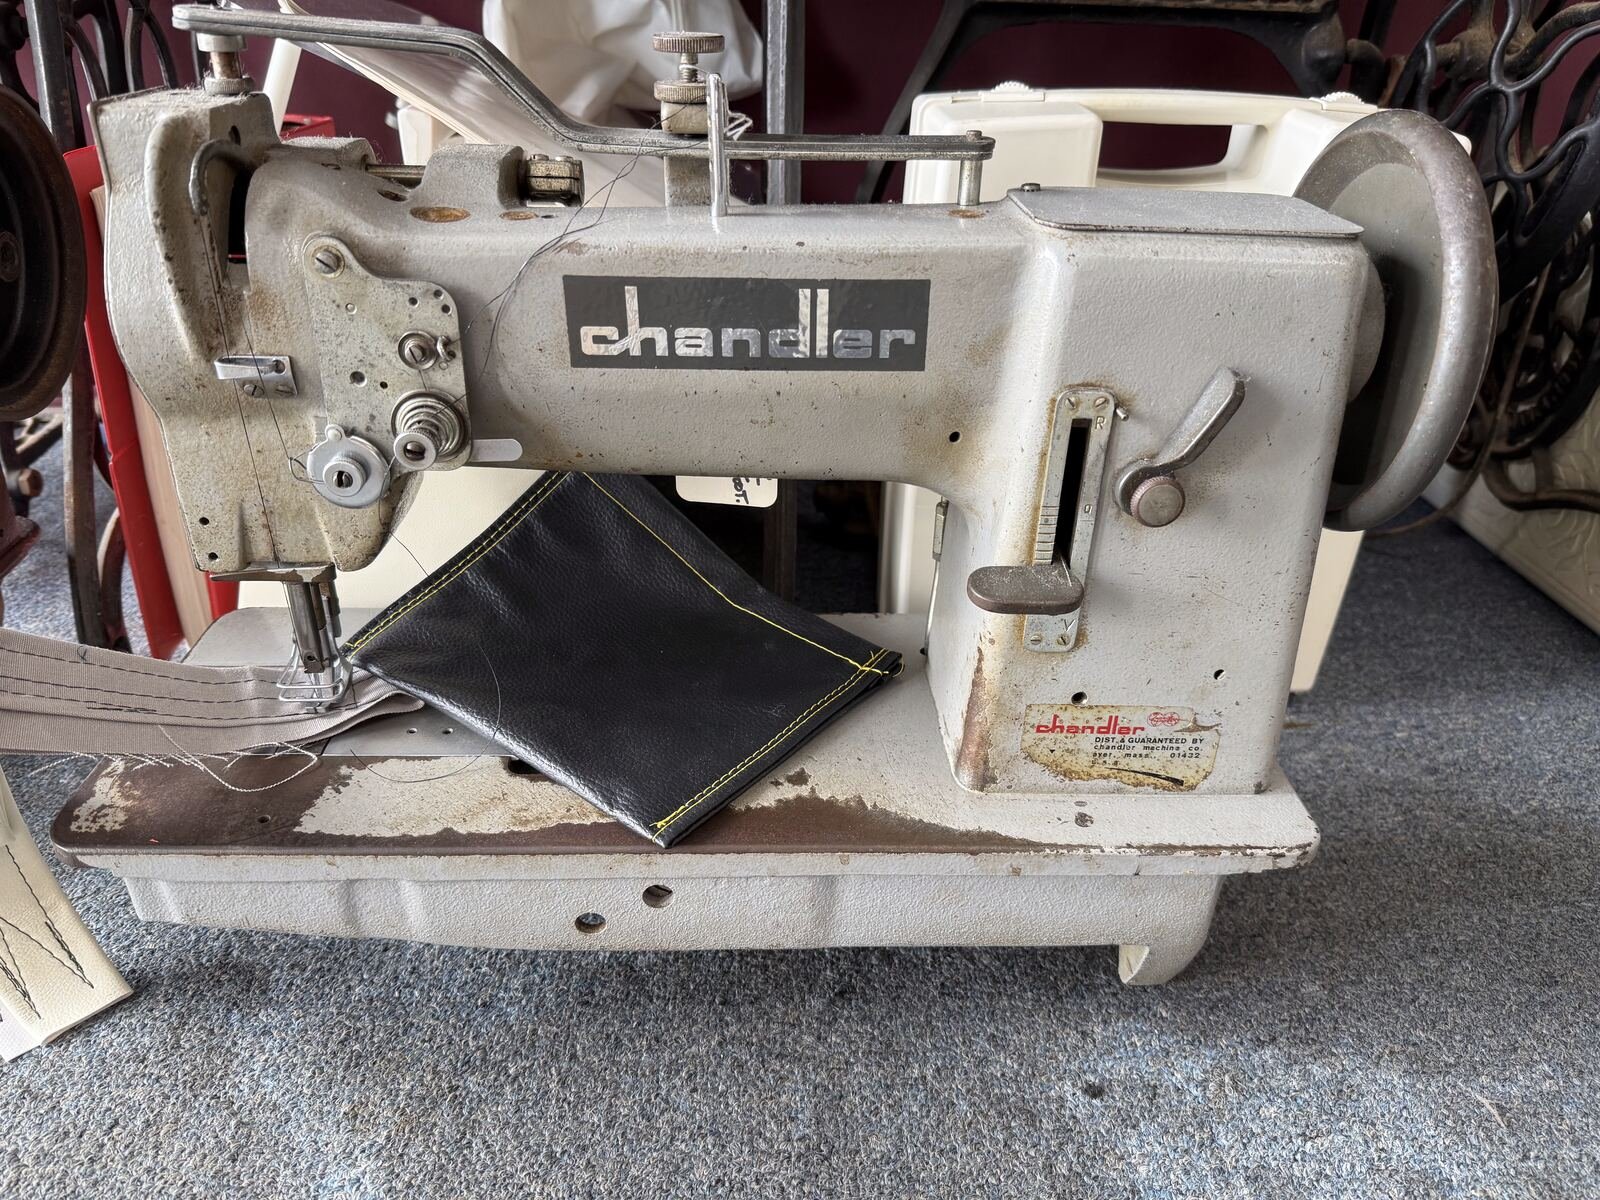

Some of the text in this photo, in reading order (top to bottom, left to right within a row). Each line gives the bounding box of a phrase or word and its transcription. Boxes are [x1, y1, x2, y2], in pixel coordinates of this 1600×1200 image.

[580, 285, 916, 358] chandler
[1095, 415, 1106, 430] R
[1035, 714, 1145, 735] chandler
[1094, 736, 1119, 744] DIST.
[1127, 737, 1187, 745] GUARANTEED
